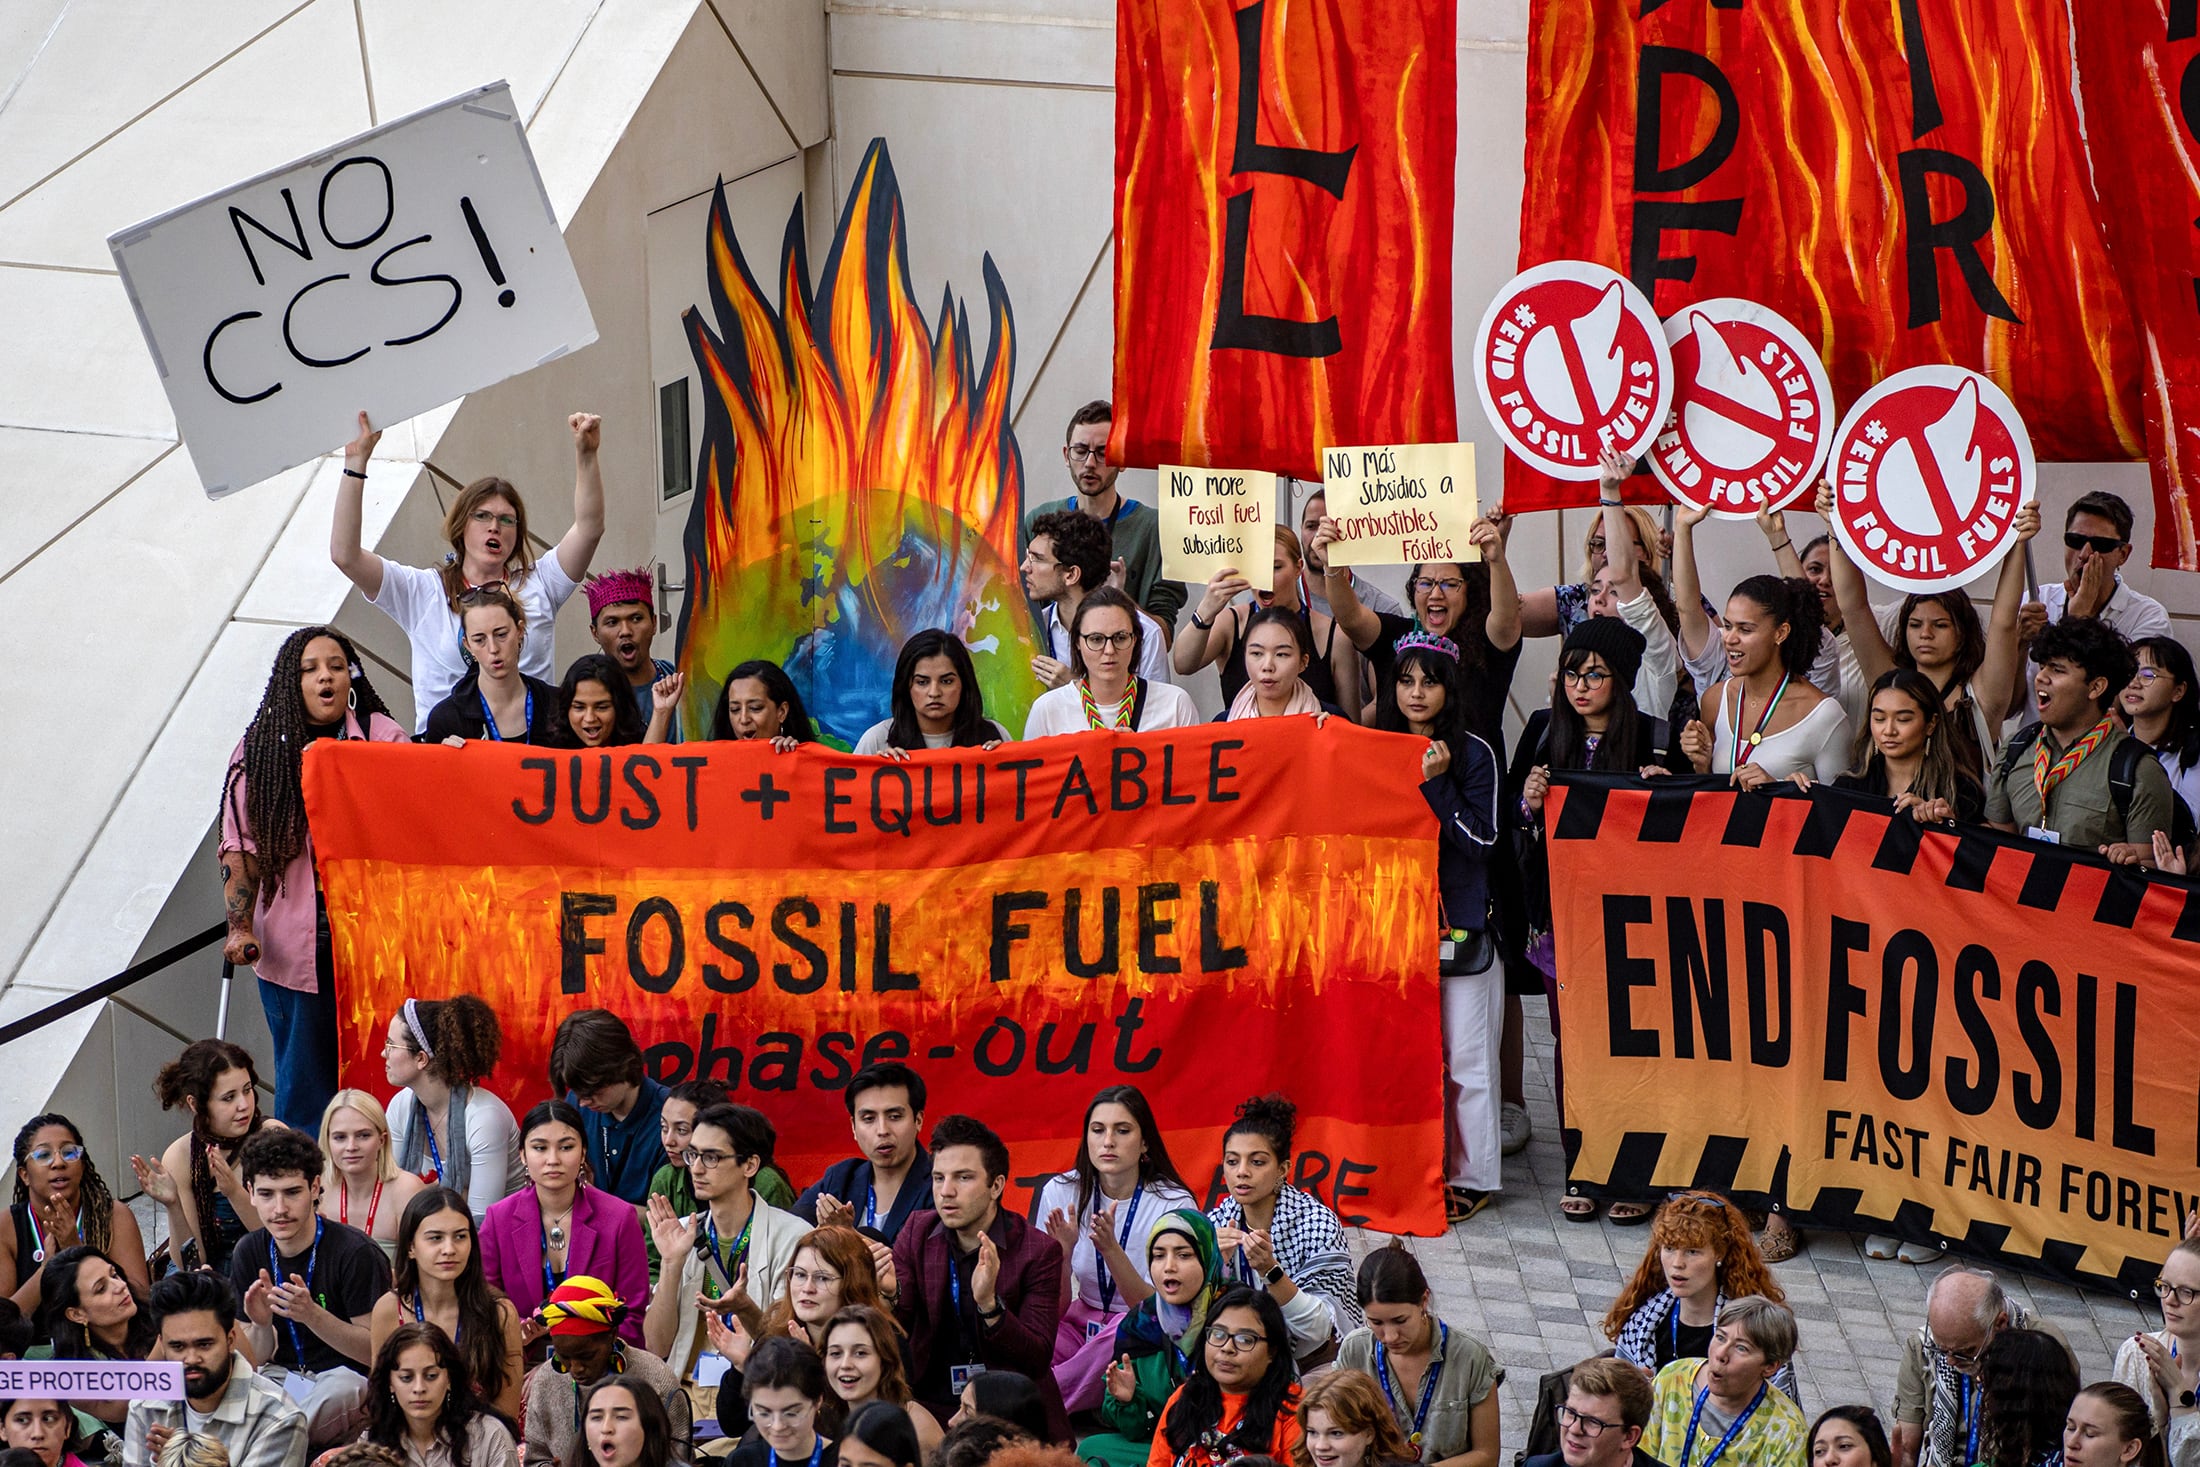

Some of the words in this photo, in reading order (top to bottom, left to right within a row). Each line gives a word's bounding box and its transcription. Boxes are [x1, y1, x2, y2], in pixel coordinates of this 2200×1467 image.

[228, 155, 394, 286] NO
[203, 196, 516, 404] CCS!
[1491, 303, 1537, 380] #END
[1500, 390, 1587, 460] FOSSIL
[1597, 361, 1654, 454] FUELS
[1709, 456, 1803, 505] FOSSIL
[1760, 342, 1814, 443] FUELS
[1206, 476, 1246, 496] more
[1360, 475, 1427, 505] subsidios
[1440, 475, 1453, 494] a
[1843, 419, 1889, 503] #END
[1183, 533, 1243, 555] subsidies
[1189, 503, 1224, 525] Fossil
[1402, 536, 1453, 561] Fósiles
[1852, 511, 1947, 573] FOSSIL
[1957, 456, 2015, 560] FUELS
[511, 754, 709, 831] JUST
[740, 773, 790, 820] +
[825, 739, 1245, 837] EQUITABLE
[561, 889, 921, 995] FOSSIL
[989, 880, 1249, 984] FUEL
[1602, 894, 1792, 1068] END
[1822, 914, 2156, 1158] FOSSIL
[1824, 1109, 1931, 1179] FAST
[1944, 1137, 2042, 1208] FAIR
[29, 1371, 172, 1391] PROTECTORS
